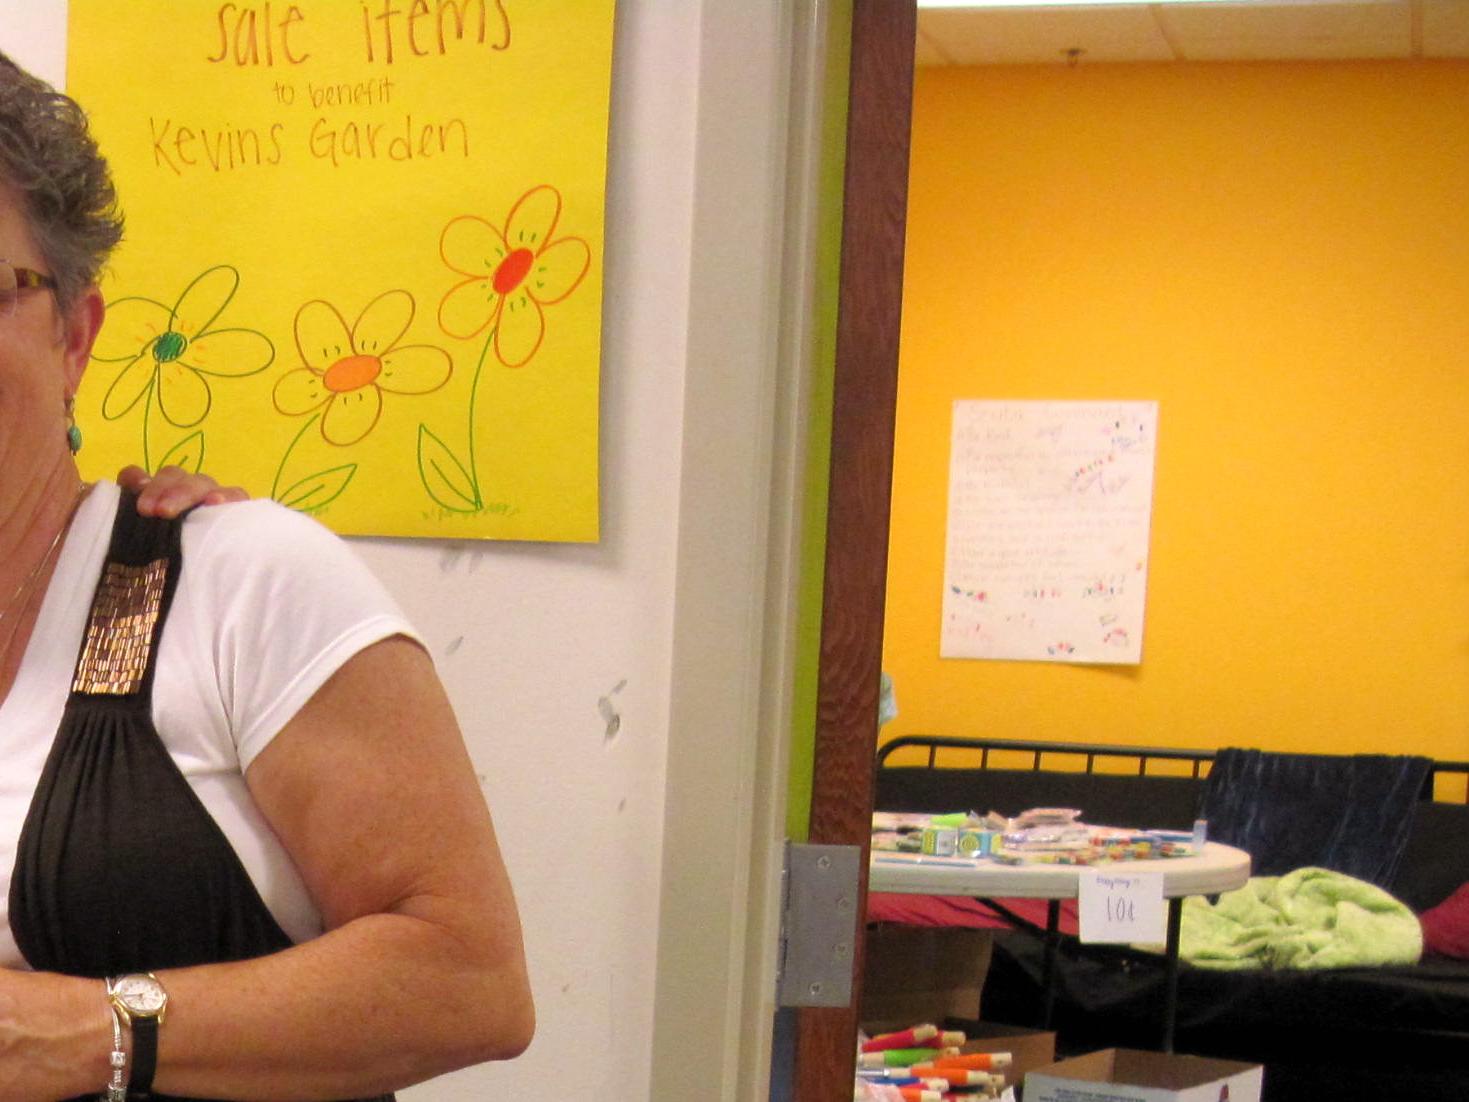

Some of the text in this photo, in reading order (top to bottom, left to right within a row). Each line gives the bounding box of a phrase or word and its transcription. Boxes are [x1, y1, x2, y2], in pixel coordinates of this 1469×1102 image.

[359, 0, 512, 65] items
[273, 77, 396, 108] to benefit
[150, 116, 470, 176] Kevins Garden
